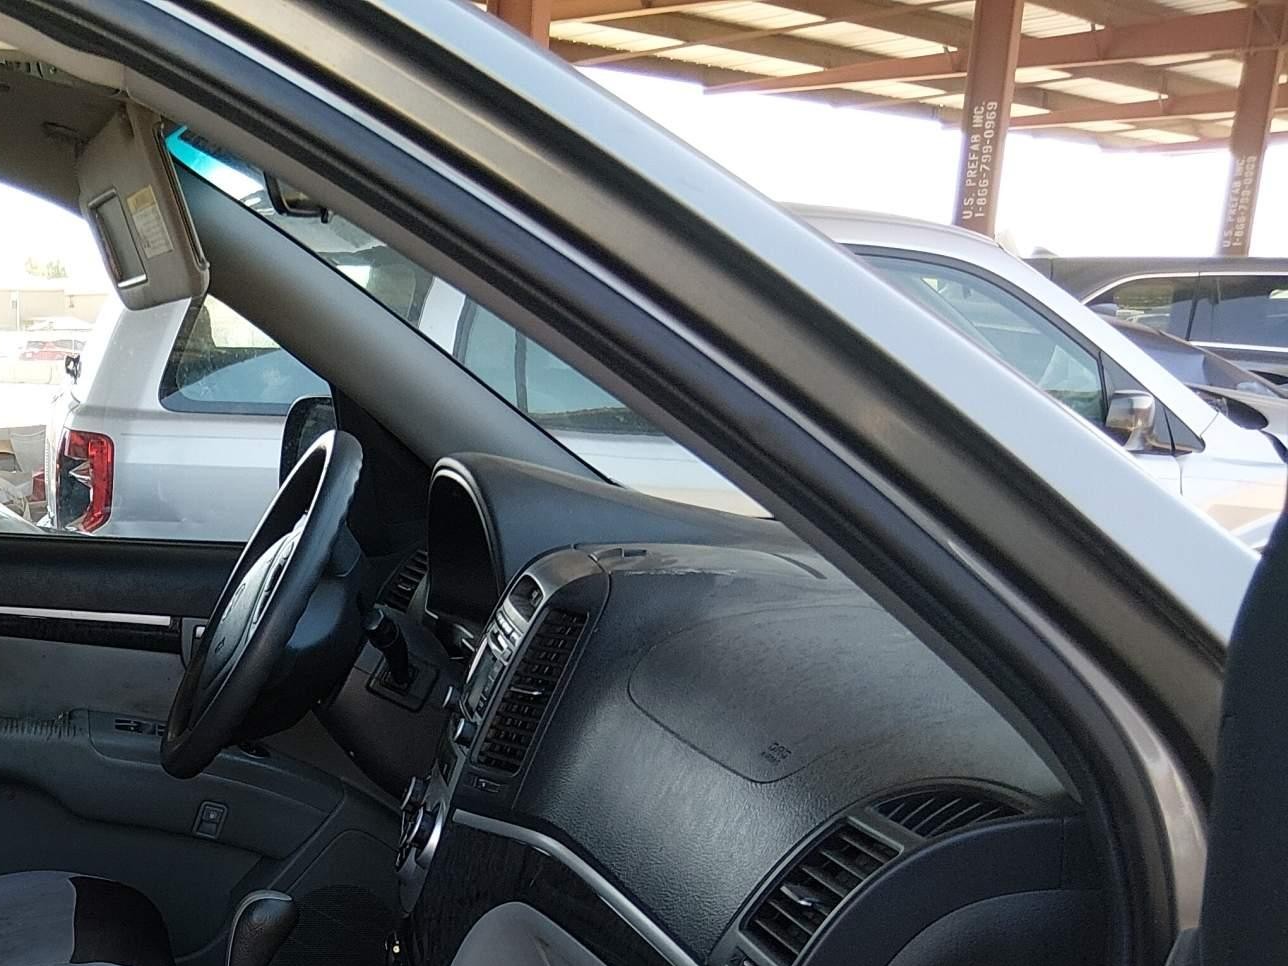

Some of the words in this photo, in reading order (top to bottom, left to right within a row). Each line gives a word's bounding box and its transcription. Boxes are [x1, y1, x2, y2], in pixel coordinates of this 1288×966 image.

[972, 101, 985, 128] INC.
[965, 133, 981, 187] PREFAB
[962, 191, 976, 220] U.S.
